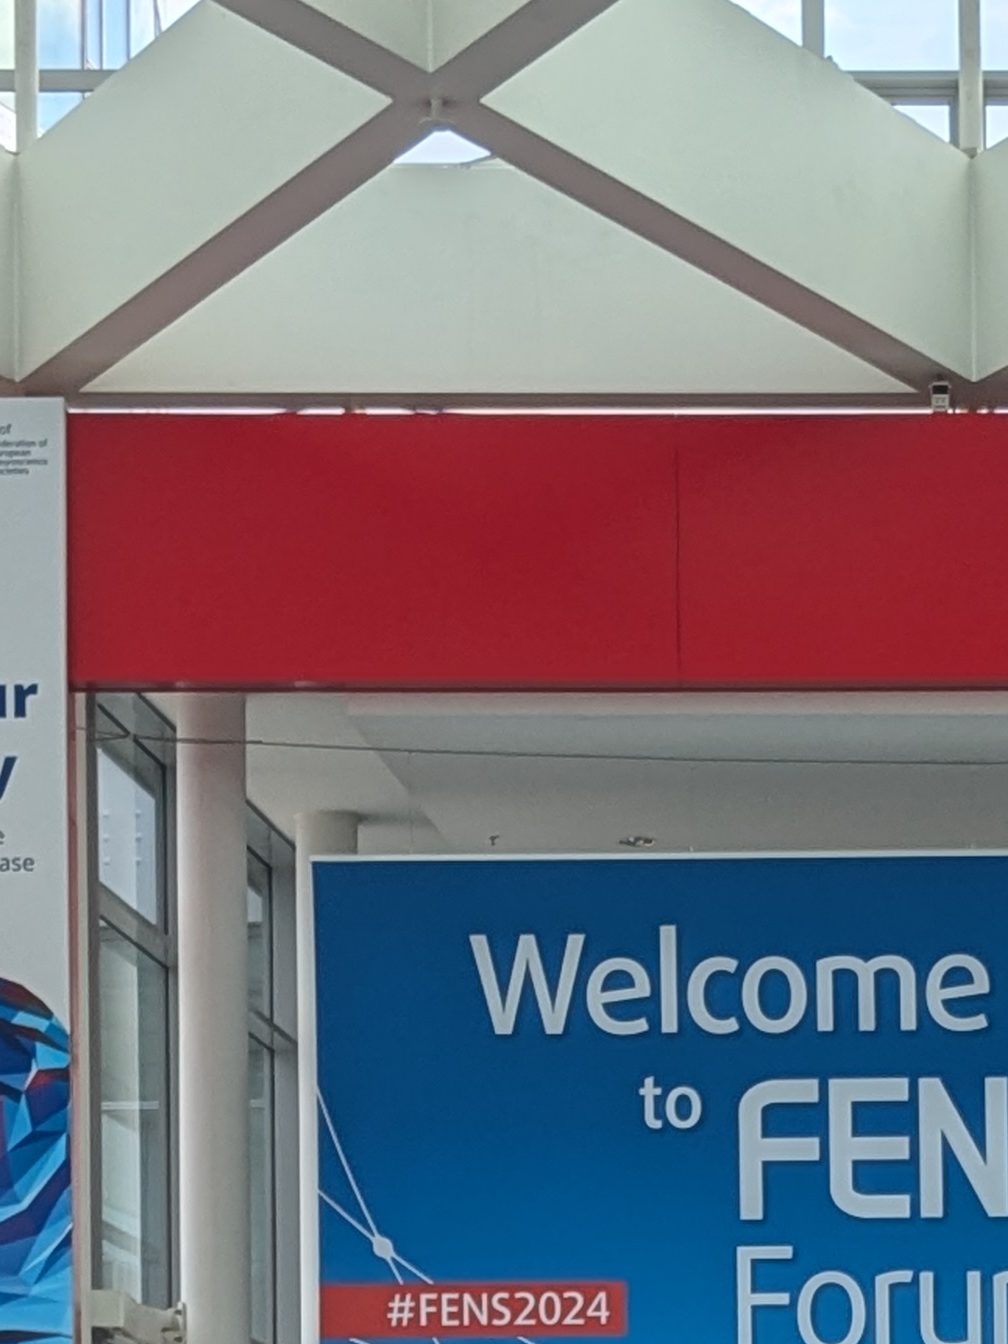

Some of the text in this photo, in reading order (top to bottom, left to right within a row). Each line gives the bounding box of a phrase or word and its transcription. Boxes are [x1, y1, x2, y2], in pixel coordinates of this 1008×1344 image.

[0, 683, 38, 718] r
[469, 925, 990, 1036] Welcome
[639, 1076, 702, 1129] to
[387, 1291, 611, 1328] #FENS2024
